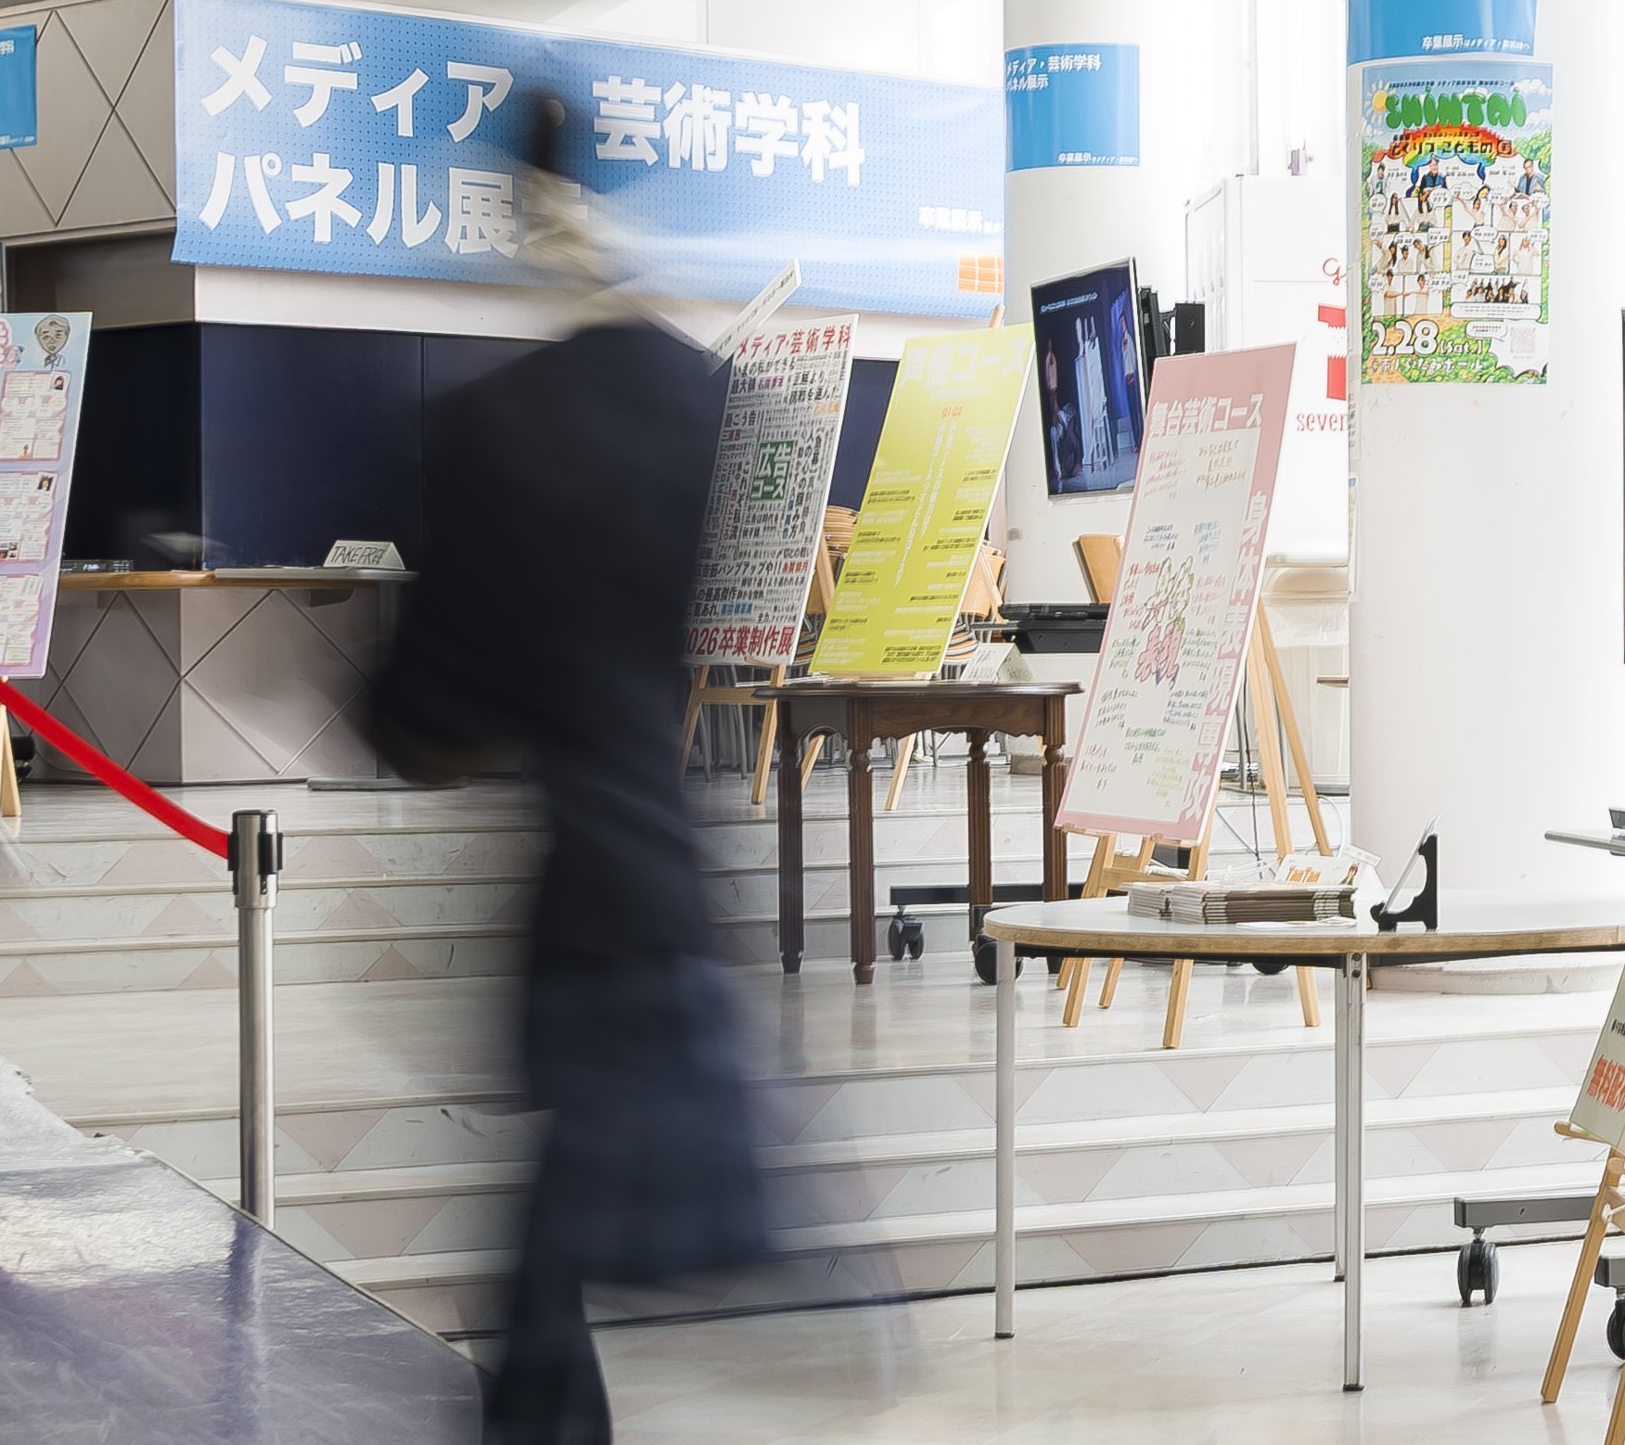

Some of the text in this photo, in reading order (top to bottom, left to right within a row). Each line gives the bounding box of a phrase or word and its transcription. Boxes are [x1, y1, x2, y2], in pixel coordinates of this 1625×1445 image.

[1006, 53, 1103, 77] メディア・芸術学科
[735, 323, 852, 361] メディア・芸術学科
[1371, 319, 1440, 356] 2.28
[1150, 391, 1265, 439] 舞台芸術コース
[755, 442, 793, 478] 広告
[750, 478, 786, 499] コース
